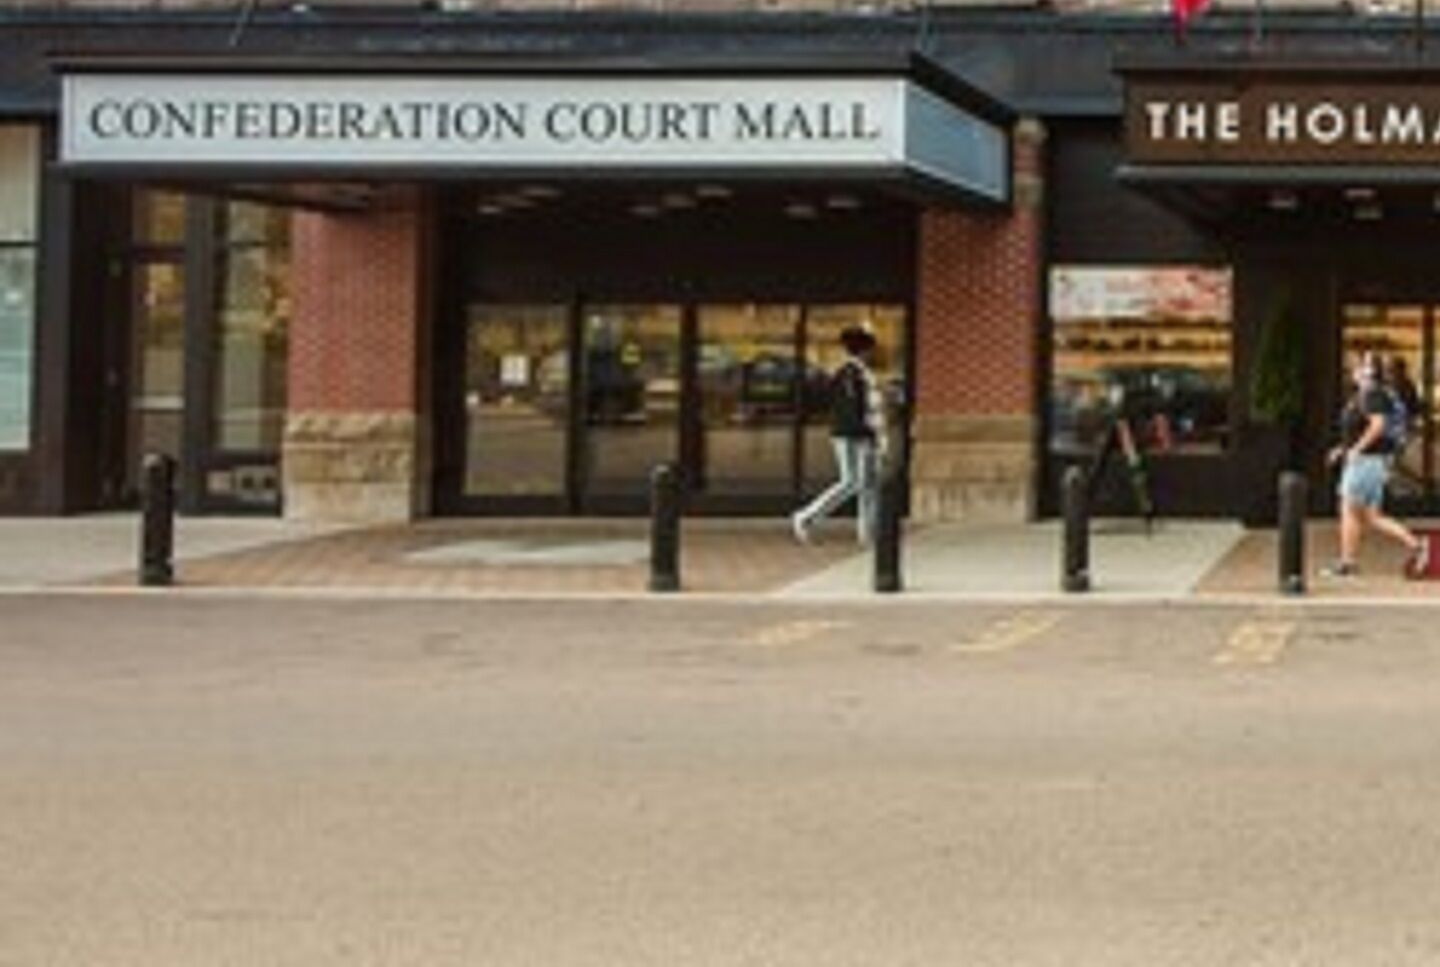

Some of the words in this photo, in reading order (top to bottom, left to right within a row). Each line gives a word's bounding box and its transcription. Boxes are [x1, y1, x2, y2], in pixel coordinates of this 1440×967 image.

[89, 101, 528, 141] CONFEDERATION
[545, 101, 720, 142] COURT
[733, 102, 882, 141] MALL
[1146, 102, 1240, 141] THE
